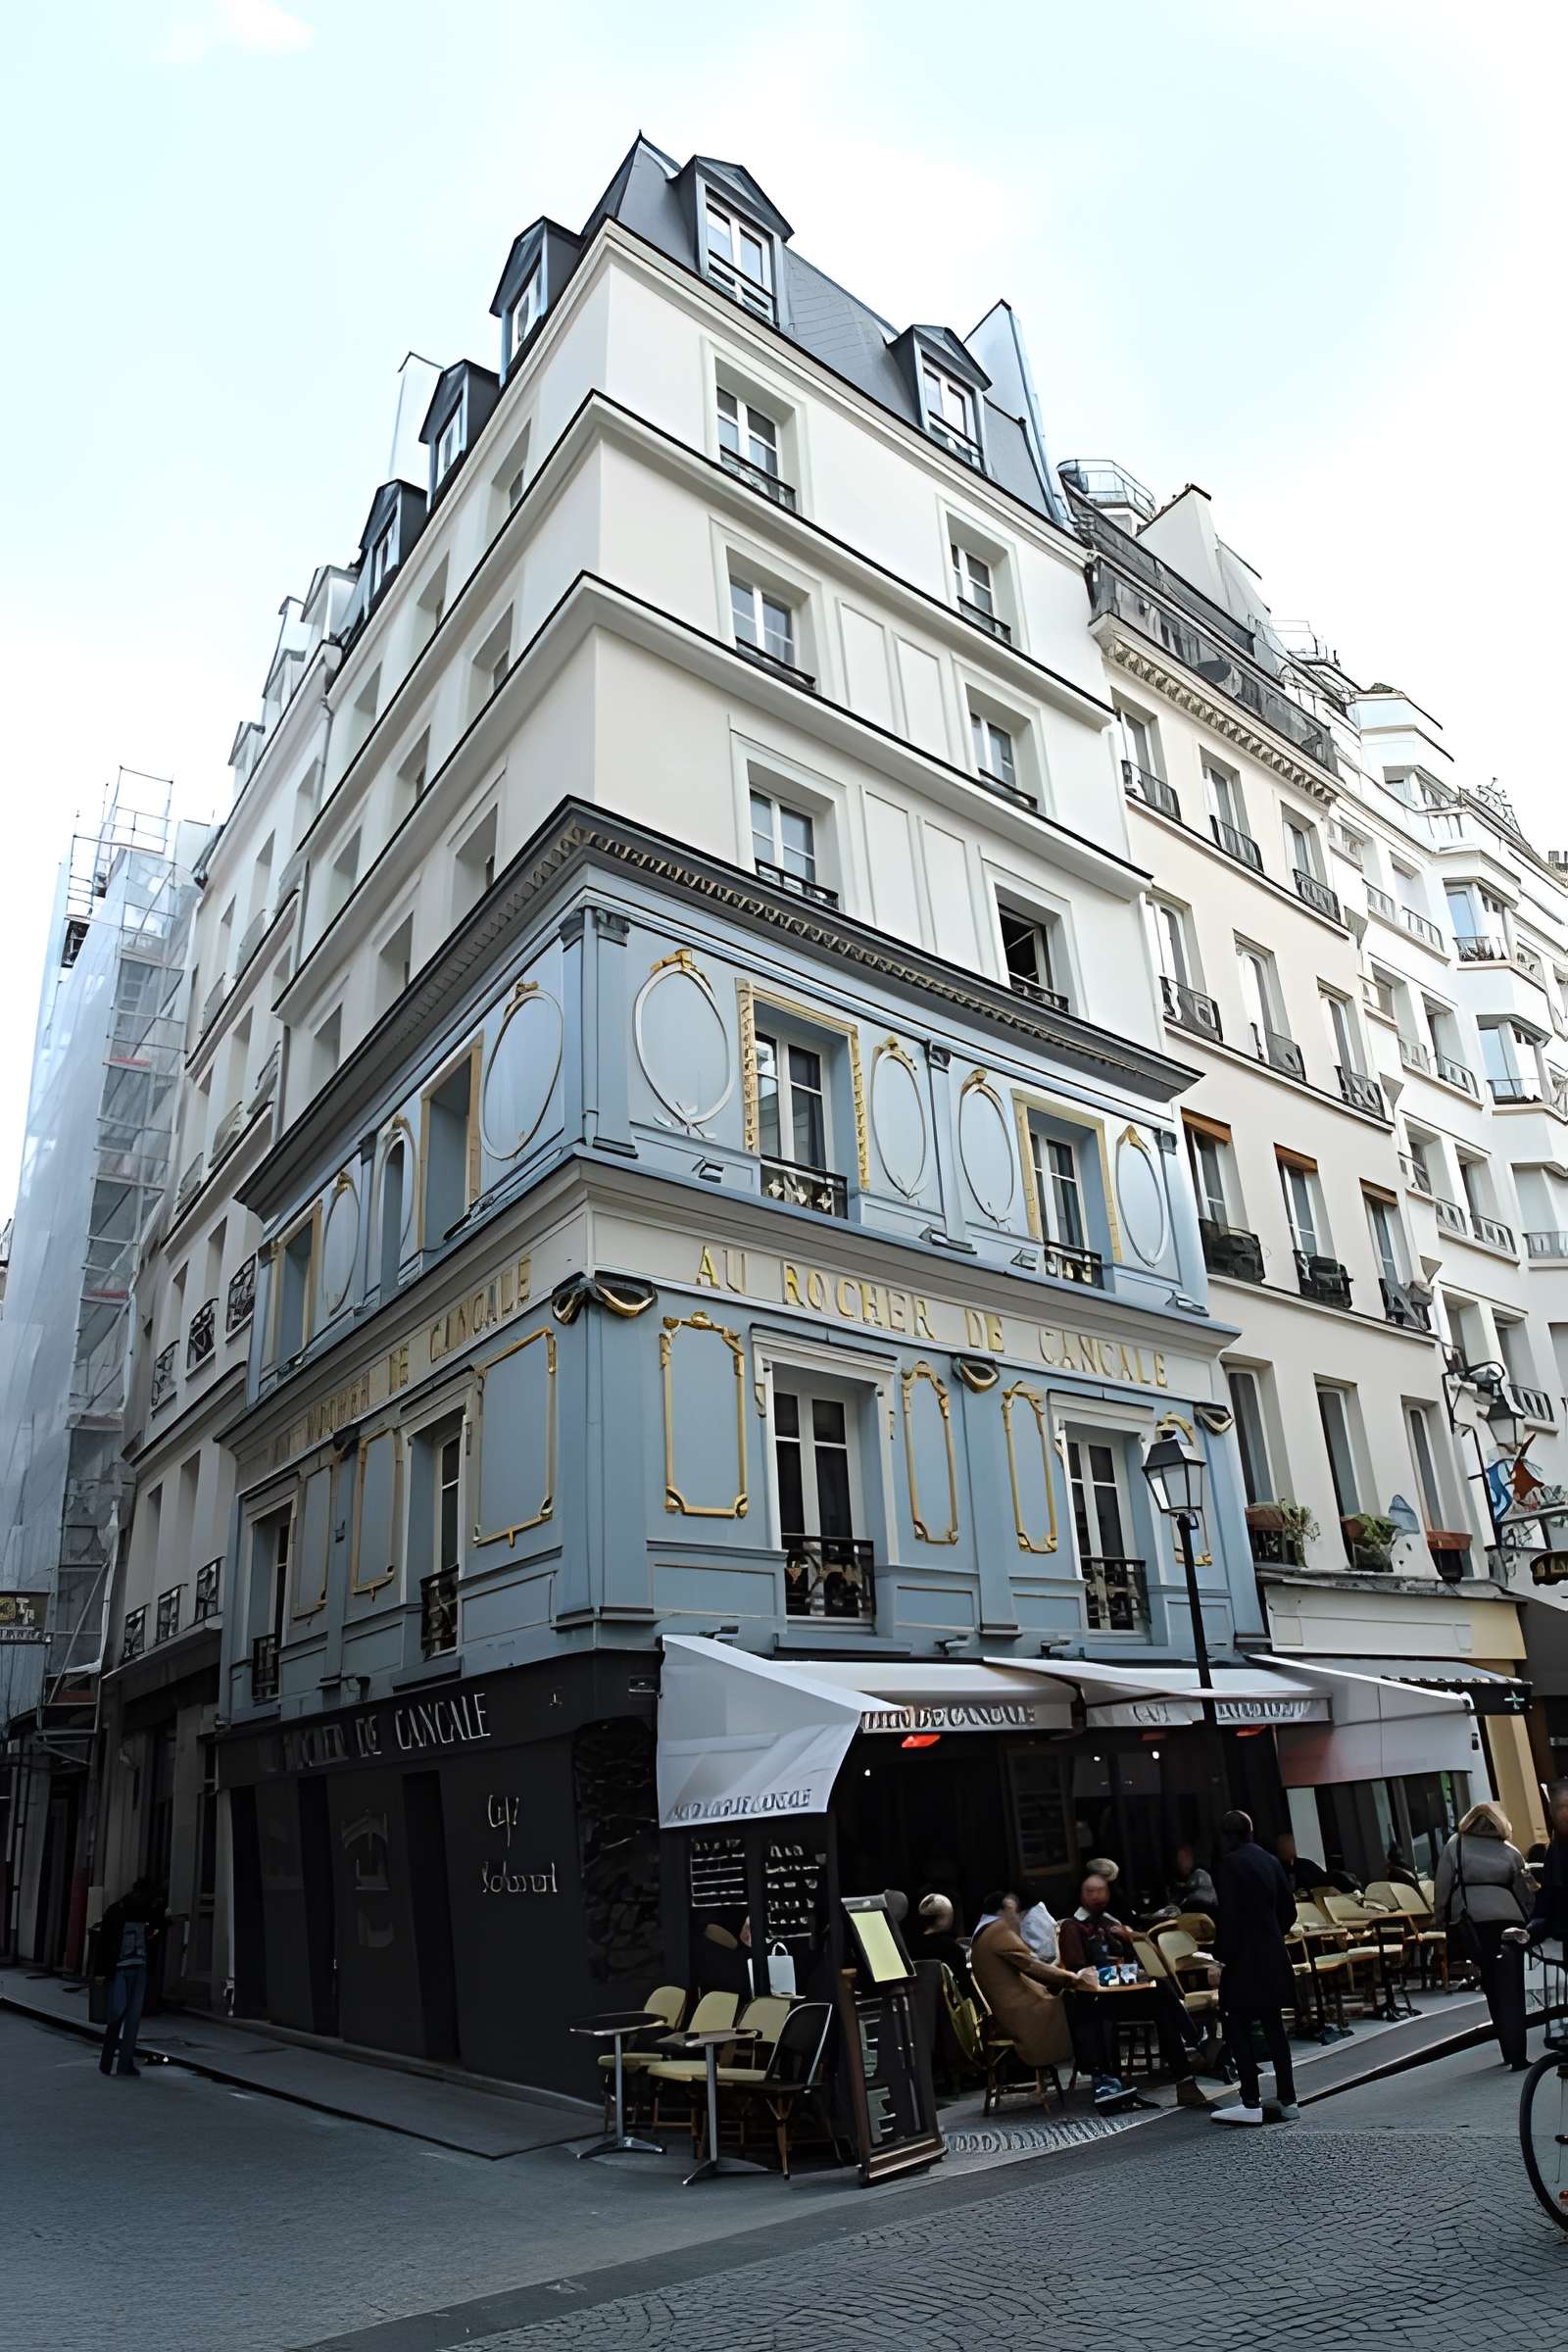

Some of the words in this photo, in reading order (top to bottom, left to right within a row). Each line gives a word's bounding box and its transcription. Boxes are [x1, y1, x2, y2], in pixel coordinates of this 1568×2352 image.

[696, 1245, 750, 1294] AU
[783, 1262, 936, 1341] ROCHER
[964, 1307, 1005, 1353] DE
[1037, 1325, 1169, 1389] CANCALE
